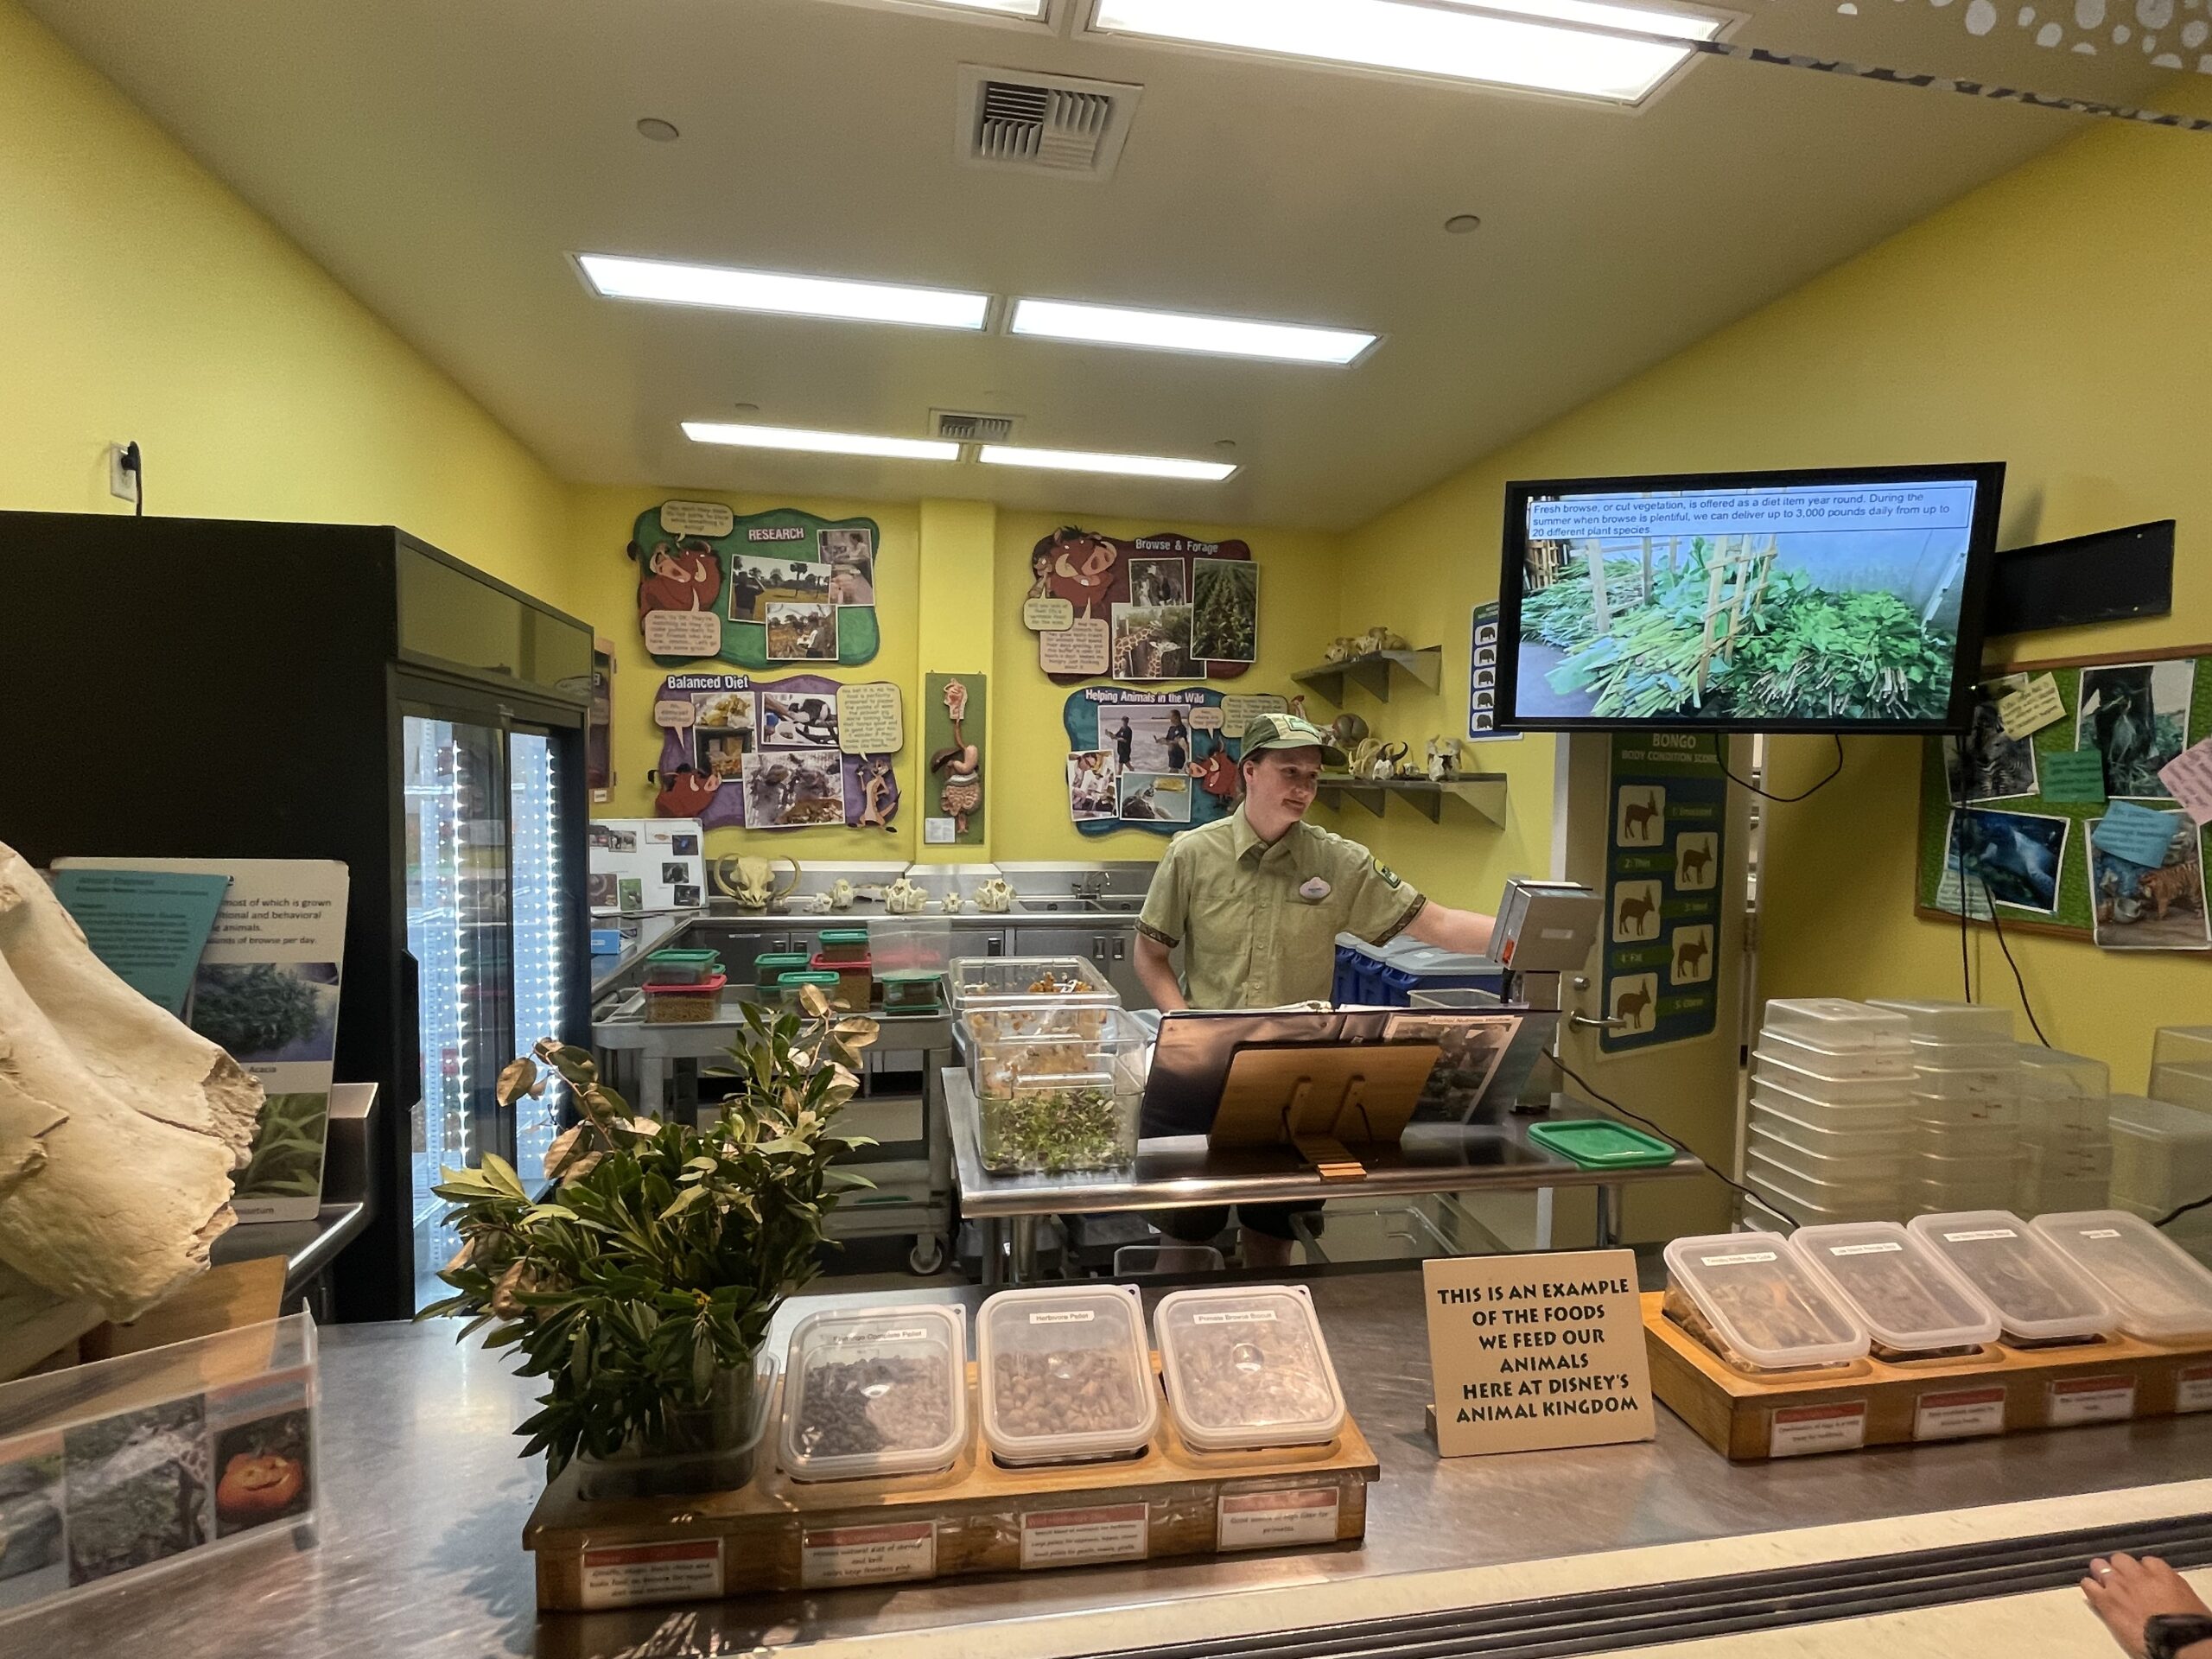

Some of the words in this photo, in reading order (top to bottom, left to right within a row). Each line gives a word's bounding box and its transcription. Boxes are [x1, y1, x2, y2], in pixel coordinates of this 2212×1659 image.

[1534, 505, 1560, 514] Fresh
[1563, 504, 1599, 513] browse,
[1616, 503, 1630, 512] cut
[1633, 501, 1685, 512] vegetation,
[1700, 499, 1734, 509] offered
[1762, 497, 1780, 506] diet
[1783, 496, 1805, 505] item
[1808, 497, 1829, 507] year
[1833, 494, 1866, 505] round.
[1870, 493, 1904, 504] During
[1908, 493, 1923, 501] the
[1573, 516, 1599, 524] when
[1602, 514, 1637, 524] browse
[1639, 514, 1647, 523] is
[1649, 512, 1690, 524] plentiful,
[1732, 511, 1764, 519] deliver
[1768, 511, 1779, 520] up
[1783, 509, 1793, 518] to
[1796, 508, 1825, 519] 3,000
[1827, 507, 1866, 518] pounds
[1869, 505, 1893, 517] daily
[1897, 505, 1919, 515] from
[1923, 505, 1936, 516] up
[1940, 504, 1950, 514] to
[748, 527, 804, 541] RESEARCH
[1532, 528, 1544, 537] 20
[1547, 526, 1585, 537] different
[1587, 525, 1611, 537] plant
[1135, 538, 1171, 551] Browse
[1174, 539, 1182, 551] &
[1186, 540, 1219, 556] Forage
[667, 676, 721, 690] Balanced
[725, 675, 749, 689] Diet
[1085, 689, 1118, 703] Helping
[1121, 690, 1155, 703] Animals
[1158, 692, 1166, 703] in
[1168, 692, 1182, 703] the
[1185, 692, 1205, 704] Wild
[1652, 733, 1697, 749] BONGO
[1621, 750, 1645, 760] BODY
[1648, 751, 1693, 762] CONDITION
[249, 899, 260, 907] of
[262, 899, 289, 907] which
[292, 899, 300, 907] is
[302, 899, 332, 908] grown
[251, 911, 270, 919] and
[271, 911, 322, 919] behavioral
[249, 936, 281, 944] browse
[1437, 1287, 1481, 1305] THIS
[1488, 1286, 1503, 1302] IS
[1509, 1284, 1537, 1300] AN
[1542, 1279, 1630, 1299] EXAMPLE
[1471, 1311, 1497, 1327] OF
[1502, 1308, 1539, 1325] THE
[1544, 1304, 1605, 1323] FOODS
[1478, 1334, 1508, 1351] WE
[1513, 1331, 1557, 1349] FEED
[1561, 1328, 1605, 1346] OUR
[1499, 1352, 1590, 1374] ANIMALS
[1463, 1381, 1513, 1401] HERE
[1517, 1379, 1543, 1396] AT
[1548, 1373, 1630, 1395] DISNEY'S
[1456, 1403, 1538, 1424] ANIMAL
[1542, 1395, 1638, 1417] KINGDOM
